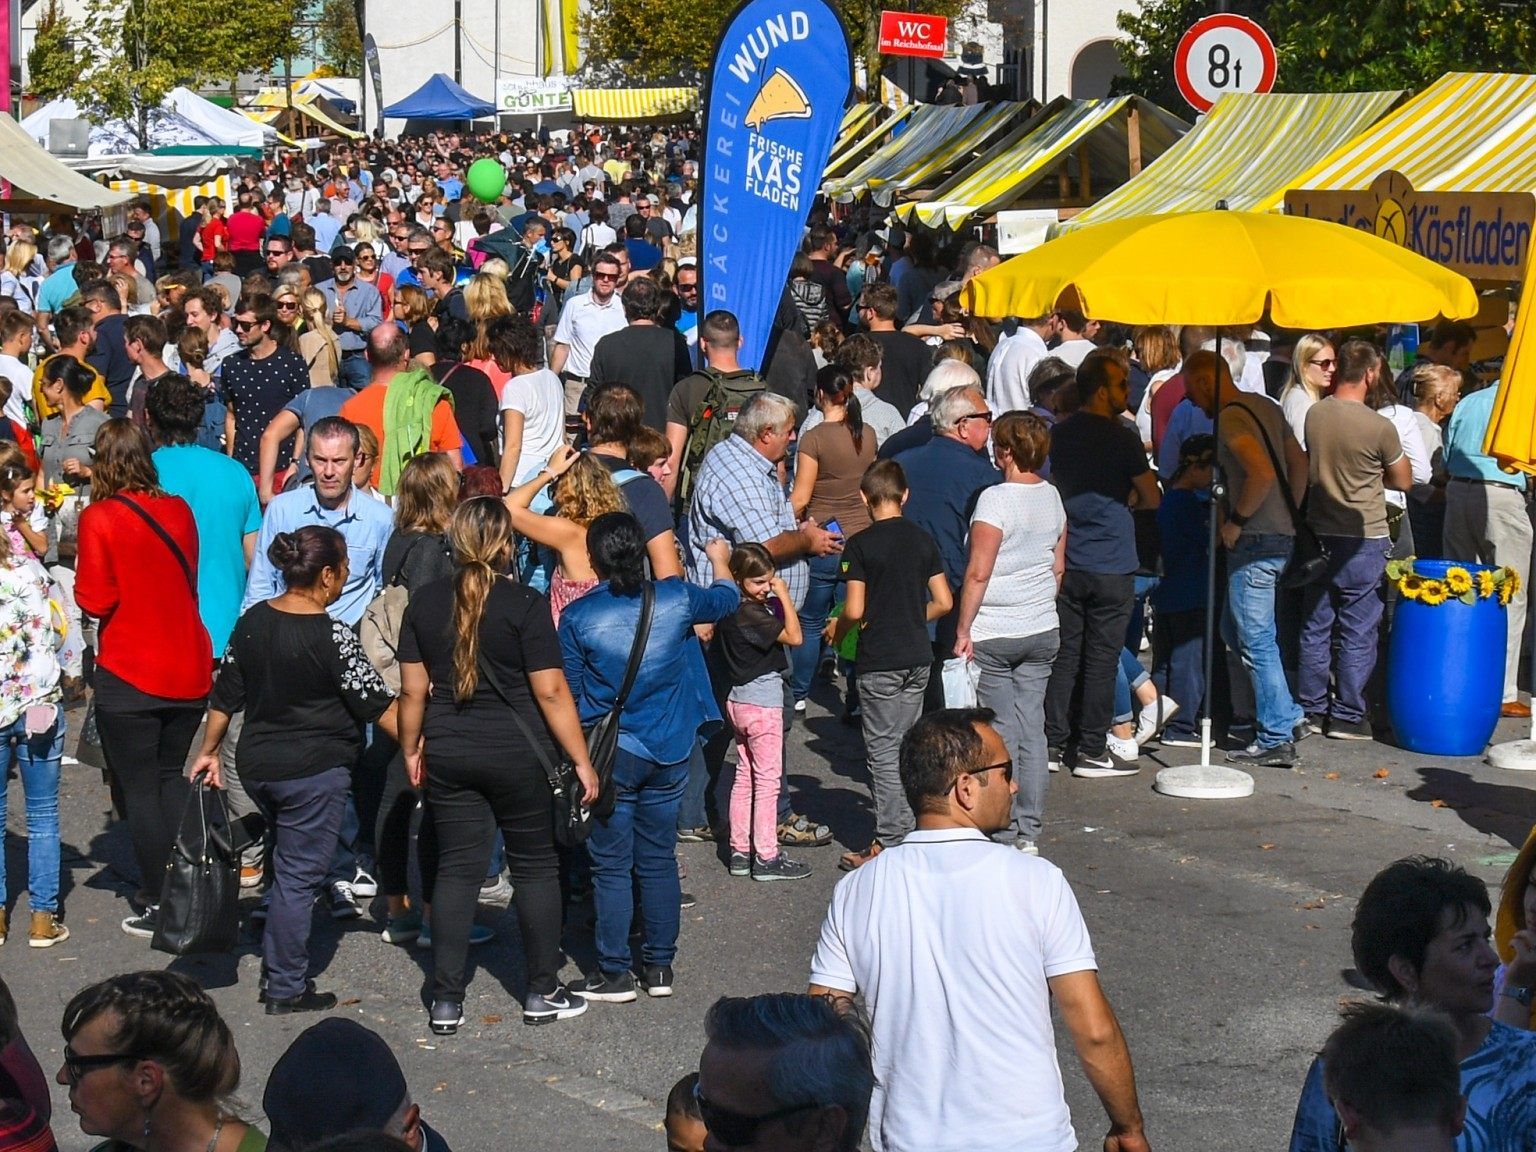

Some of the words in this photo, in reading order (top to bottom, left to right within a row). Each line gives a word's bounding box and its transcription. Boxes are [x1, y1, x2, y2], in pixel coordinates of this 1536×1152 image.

[728, 10, 810, 84] WUND
[880, 37, 892, 46] im
[893, 38, 944, 51] Reichshofsaal
[898, 21, 931, 39] WC
[745, 146, 802, 195] KÄS
[749, 132, 803, 167] FRISCHE
[709, 91, 741, 301] BÄCKEREI
[745, 179, 800, 211] FLADEN
[1412, 205, 1531, 266] Käsfladen
